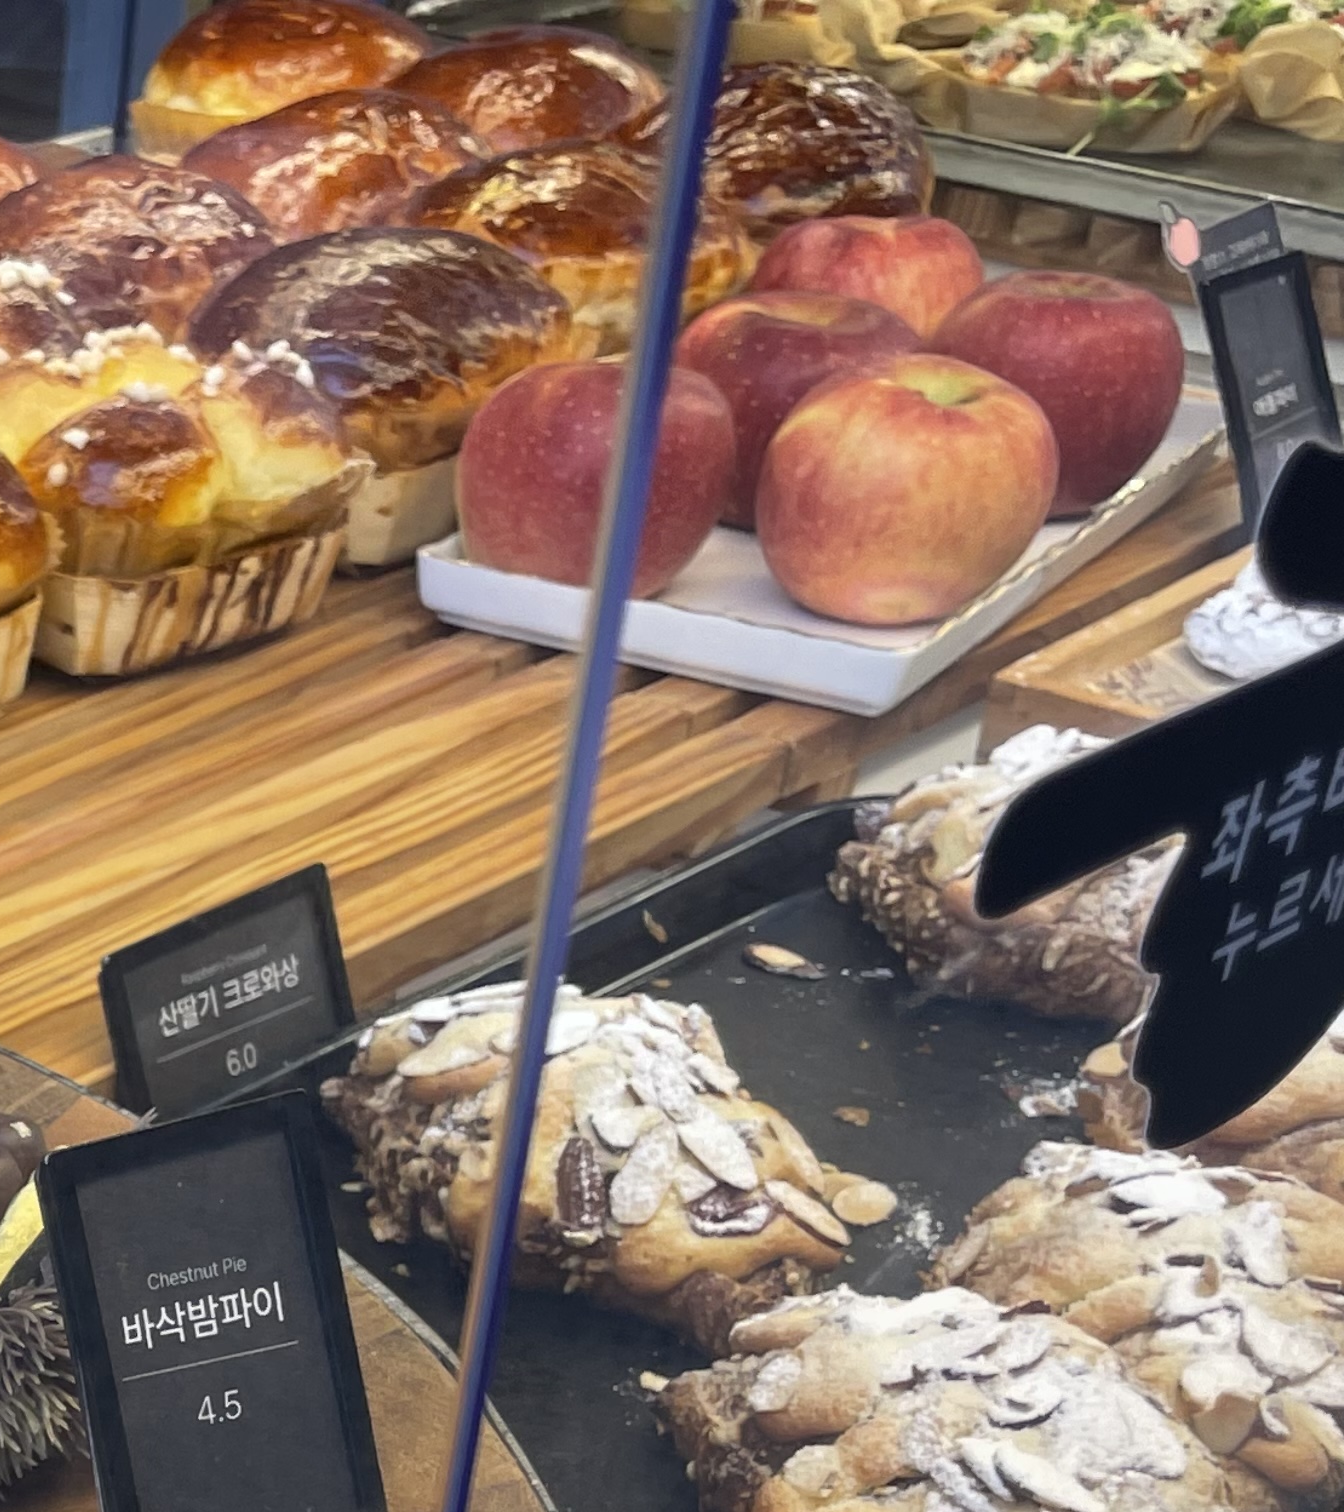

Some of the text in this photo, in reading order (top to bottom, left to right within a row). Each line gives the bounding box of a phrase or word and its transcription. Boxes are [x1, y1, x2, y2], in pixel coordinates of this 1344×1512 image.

[222, 953, 300, 1010] 크로와상
[226, 1042, 257, 1076] 6.0
[147, 1256, 248, 1291] Chestnut Pie
[121, 1280, 285, 1350] 바삭밤파이
[197, 1388, 243, 1425] 4.5
